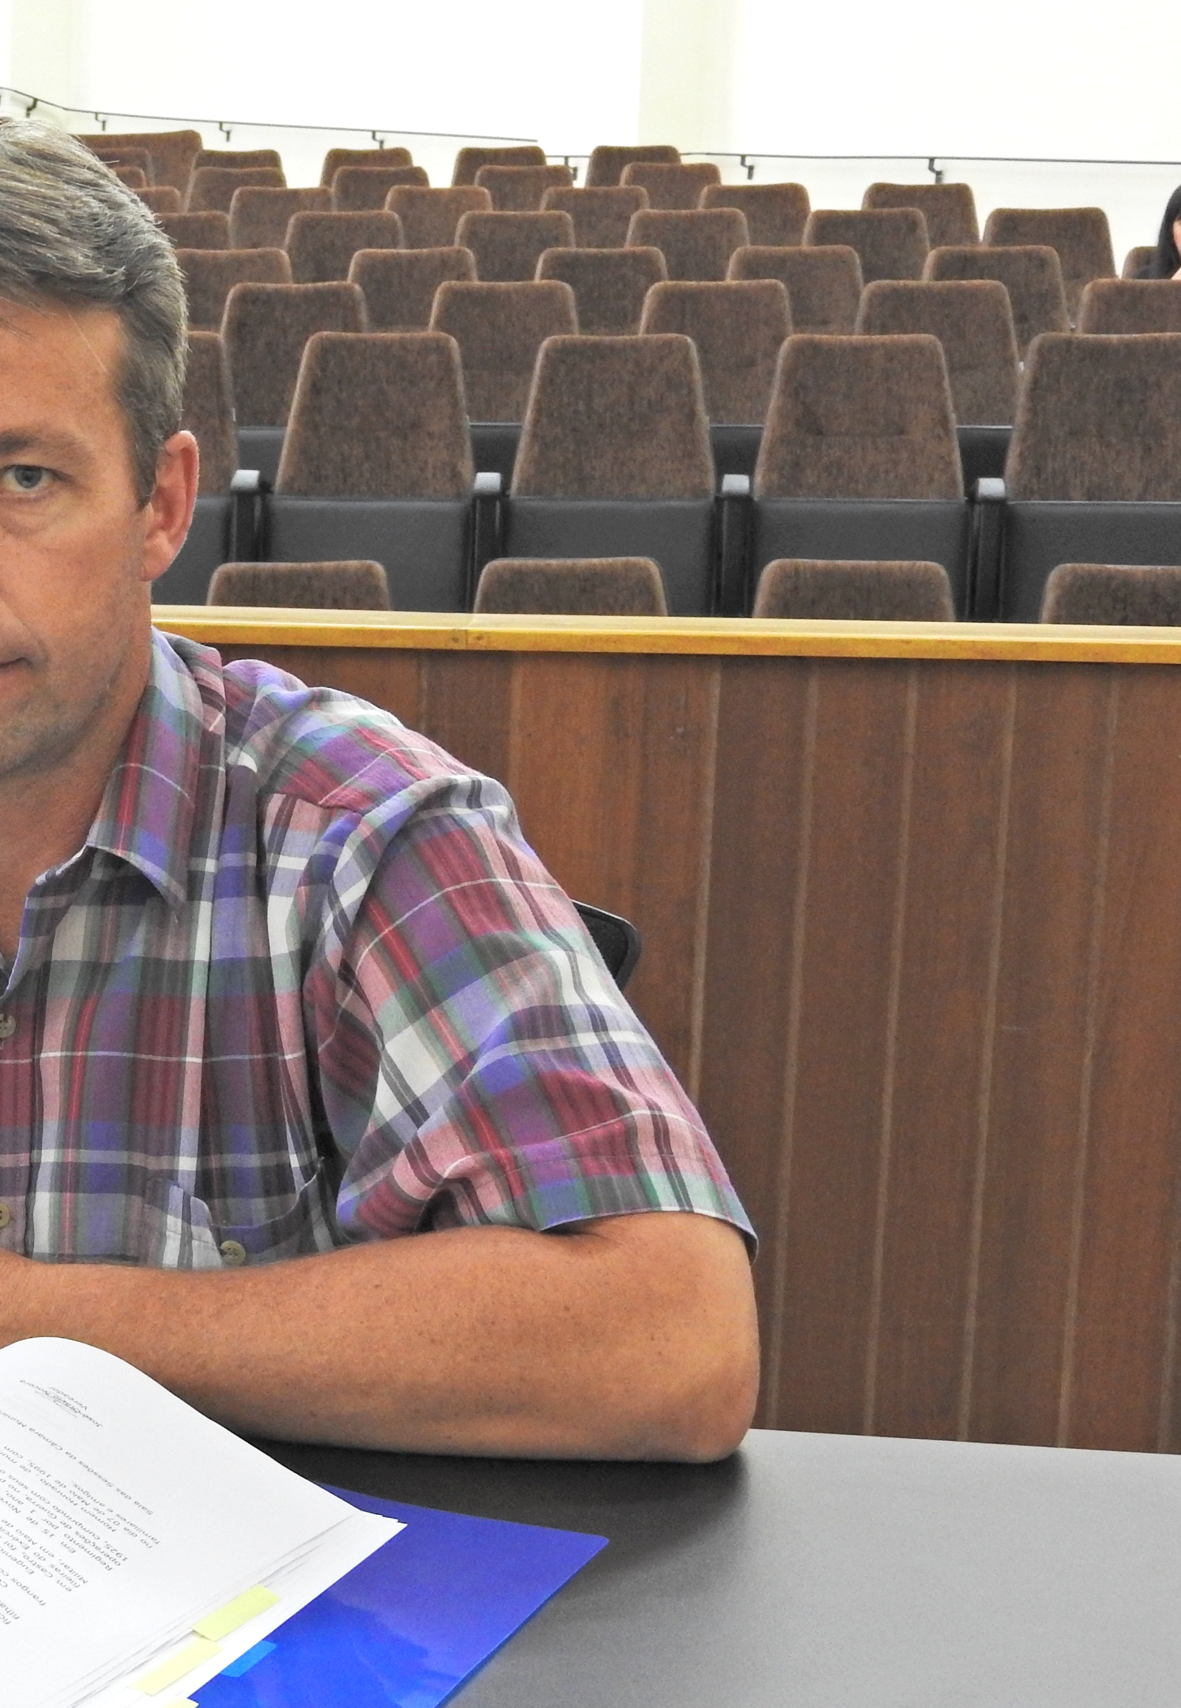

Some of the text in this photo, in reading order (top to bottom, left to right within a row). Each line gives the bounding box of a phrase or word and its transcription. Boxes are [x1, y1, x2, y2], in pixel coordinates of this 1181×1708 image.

[2, 1445, 23, 1459] com
[64, 1451, 77, 1460] da
[18, 1464, 31, 1473] de
[6, 1474, 29, 1490] seus
[6, 1484, 20, 1493] no
[53, 1479, 67, 1488] de
[30, 1490, 51, 1504] com
[68, 1489, 90, 1506] Maio
[114, 1487, 132, 1500] das
[91, 1507, 105, 1515] de
[0, 1519, 14, 1528] de
[25, 1516, 39, 1525] de
[41, 1517, 59, 1530] por
[51, 1504, 101, 1540] cumprindo
[58, 1520, 72, 1529] de
[79, 1506, 116, 1532] Homem
[41, 1528, 55, 1538] 15
[115, 1512, 160, 1544] familiares
[122, 1526, 138, 1537] dia
[14, 1528, 37, 1545] Maio
[3, 1540, 17, 1551] foi
[59, 1541, 76, 1554] Em
[139, 1538, 153, 1549] no
[32, 1551, 46, 1561] do
[38, 1545, 55, 1558] em
[62, 1533, 114, 1571] Regimento
[48, 1563, 80, 1588] fileiras
[9, 1577, 47, 1606] frangos
[55, 1579, 72, 1592] em
